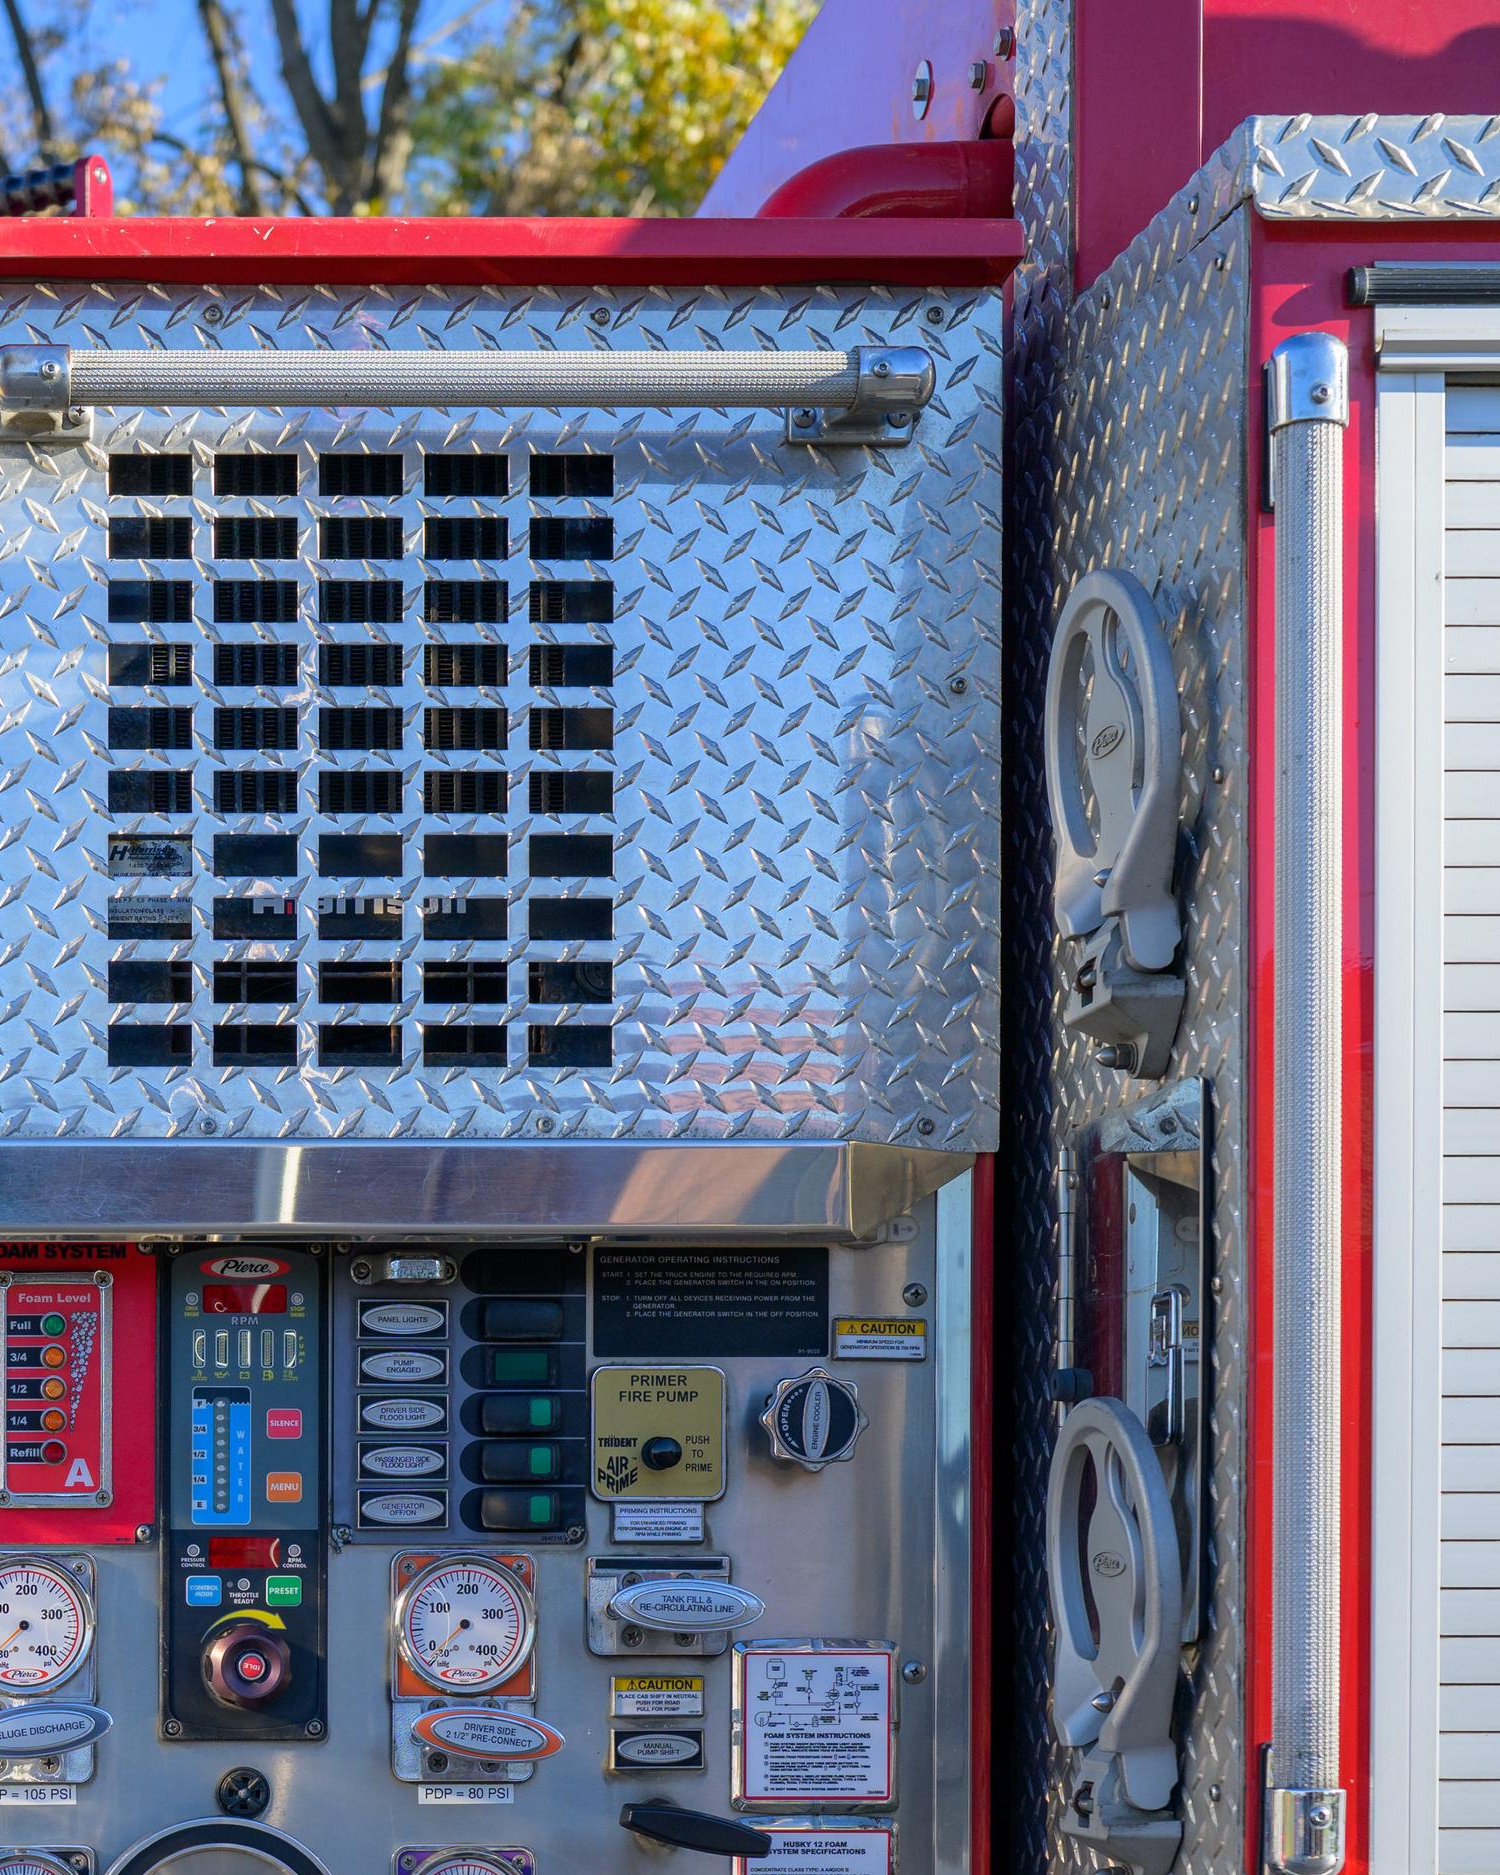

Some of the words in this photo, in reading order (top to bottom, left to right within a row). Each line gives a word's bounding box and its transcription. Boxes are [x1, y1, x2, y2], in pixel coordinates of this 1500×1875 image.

[44, 1243, 127, 1259] SYSTEM
[599, 1256, 656, 1265] GENERATOR
[657, 1256, 710, 1265] OPERATING
[712, 1256, 780, 1265] INSTRUCTIONS
[219, 1258, 272, 1276] Pierce
[17, 1292, 53, 1304] Foam
[56, 1292, 92, 1304] Level
[230, 1316, 260, 1326] RPM
[377, 1315, 399, 1323] PANEL
[401, 1315, 429, 1323] LIGHTS
[9, 1320, 32, 1331] Full
[860, 1323, 916, 1335] CAUTION
[9, 1351, 28, 1363] 3/4
[393, 1359, 415, 1367] PUMP
[385, 1366, 422, 1374] ENGAGED
[630, 1374, 688, 1388] PRIMER
[9, 1383, 28, 1395] 1/2
[618, 1390, 653, 1403] FIRE
[656, 1390, 699, 1403] PUMP
[811, 1391, 821, 1419] COOLER
[9, 1415, 28, 1427] 1/4
[269, 1419, 300, 1428] SILENCE
[193, 1425, 207, 1434] 3/4
[811, 1419, 821, 1450] ENGINE
[685, 1435, 710, 1445] PUSH
[9, 1446, 41, 1458] Refill
[193, 1450, 207, 1459] 1/2
[691, 1449, 704, 1459] TO
[606, 1456, 629, 1475] AIR
[684, 1463, 713, 1473] PRIME
[64, 1458, 95, 1487] A
[193, 1475, 207, 1484] 1/4
[597, 1469, 638, 1494] PRIME
[270, 1482, 300, 1492] MENU
[228, 1591, 259, 1599] THROTTLE
[268, 1586, 300, 1596] PRESET
[637, 1679, 693, 1690] CAUTION
[29, 1720, 86, 1736] DISCHARGE
[763, 1732, 790, 1740] FOAM
[790, 1732, 824, 1740] SYSTEM
[825, 1732, 871, 1740] INSTRUCTIONS
[643, 1742, 674, 1750] MANUAL
